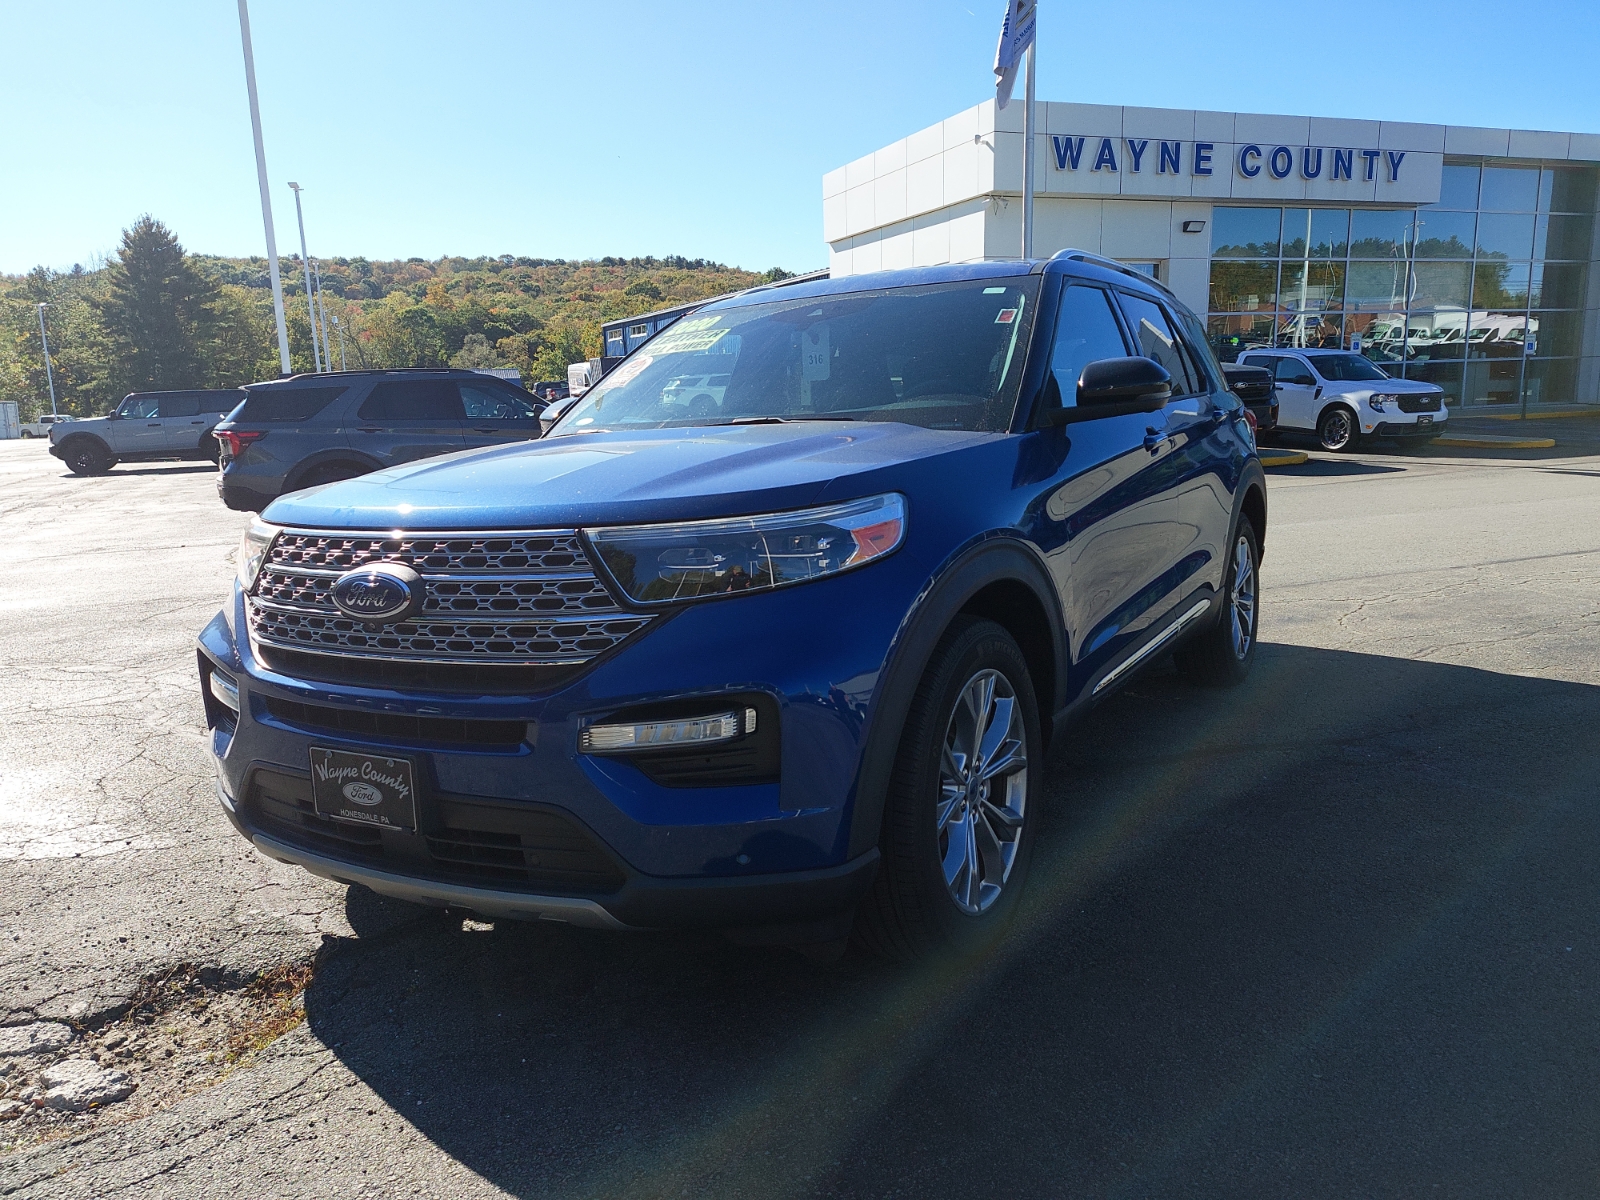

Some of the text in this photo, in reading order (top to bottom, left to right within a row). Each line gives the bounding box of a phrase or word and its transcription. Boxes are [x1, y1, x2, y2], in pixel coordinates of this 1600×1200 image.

[1052, 135, 1406, 182] WAYNE COUNTY
[808, 354, 824, 365] 316
[345, 581, 389, 607] Ford
[315, 758, 410, 799] Wayne County
[350, 785, 375, 801] Ford
[340, 808, 390, 824] HONESDALE, PA
